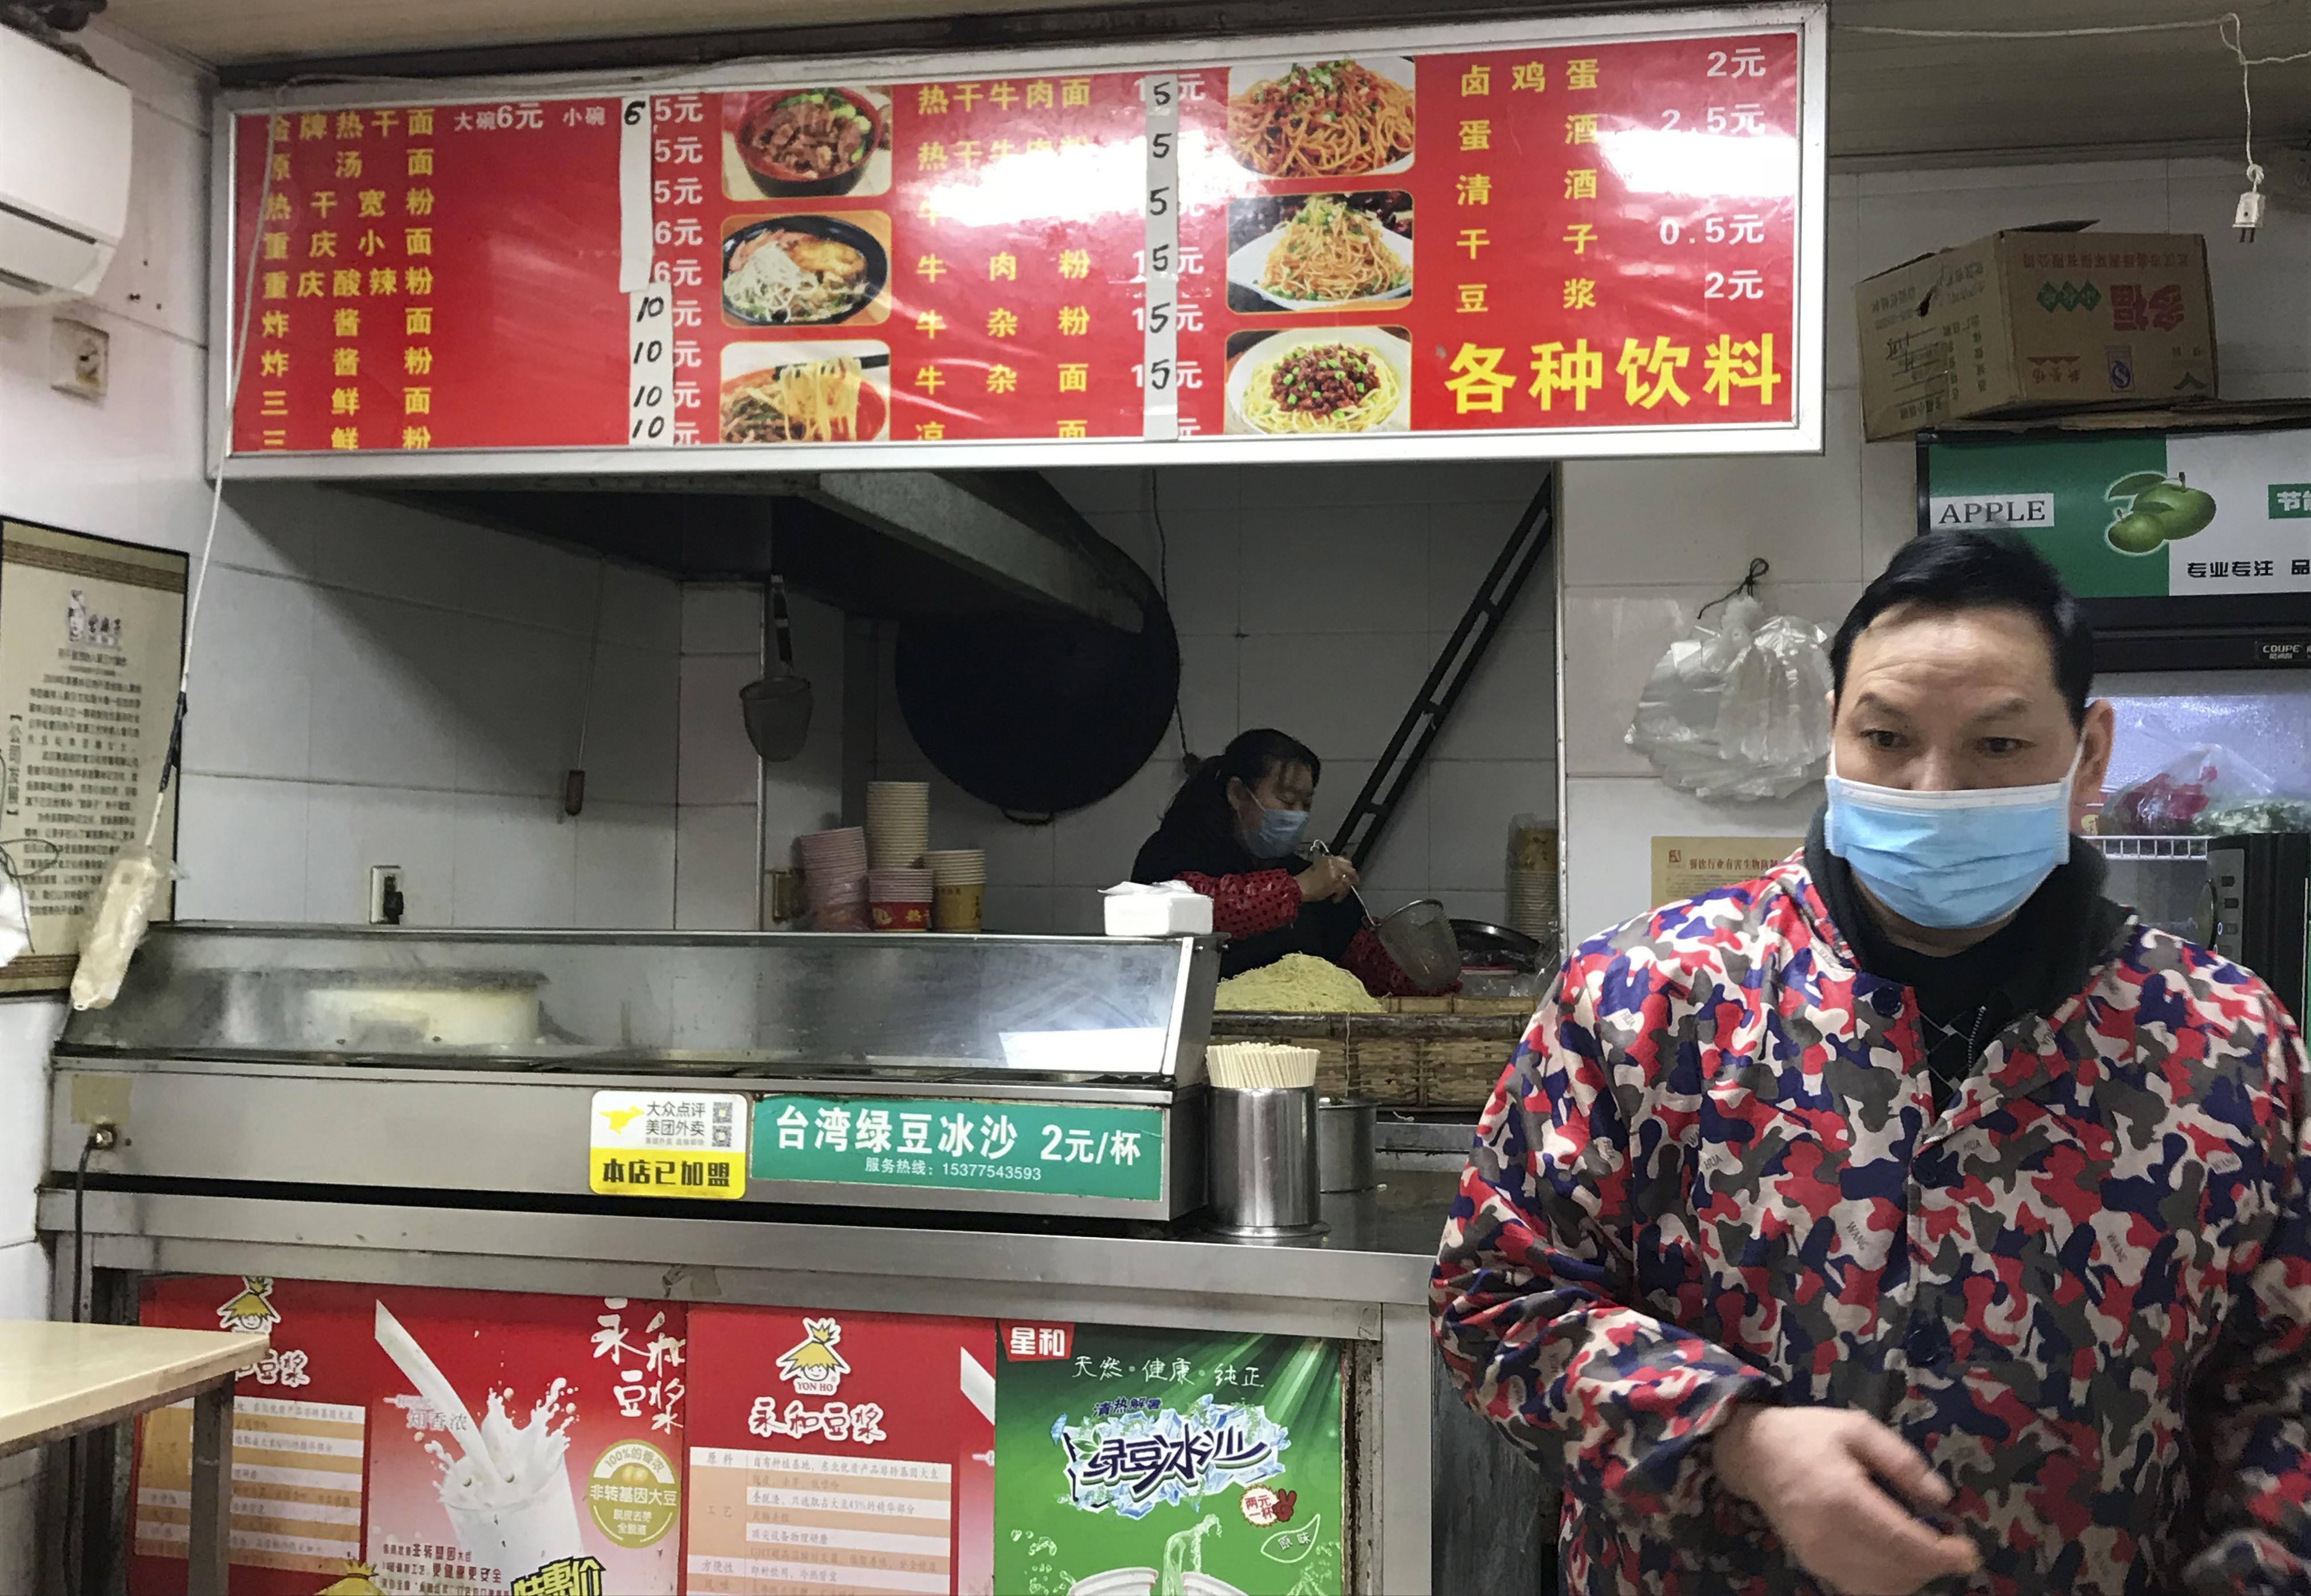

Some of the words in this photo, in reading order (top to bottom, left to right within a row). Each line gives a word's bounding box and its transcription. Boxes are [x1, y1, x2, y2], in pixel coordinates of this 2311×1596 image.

[1460, 58, 1599, 97] 卤鸡蛋
[1707, 47, 1766, 79] 2元
[918, 78, 1091, 115] 热干牛肉面
[1459, 113, 1599, 151] 蛋酒
[655, 136, 703, 164] 5元
[264, 187, 434, 221] 热干宽粉
[654, 177, 703, 205] 5元
[1456, 168, 1598, 206] 清酒
[264, 228, 433, 259] 重庆小面
[655, 218, 703, 247] 6元
[1456, 223, 1598, 259] 干子
[1659, 214, 1765, 245] 0.5元
[263, 266, 433, 299] 重庆酸辣粉
[655, 259, 702, 287] 6元
[916, 249, 1091, 283] 牛肉粉
[1456, 278, 1597, 313] 豆浆
[1705, 269, 1764, 300] 2元
[262, 307, 433, 338] 炸酱面
[915, 305, 1090, 339] 牛杂粉
[261, 346, 433, 377] 炸酱粉
[1444, 333, 1781, 414] 各种饮料
[915, 363, 1088, 394] 牛杂面
[261, 387, 432, 416] 三鲜面
[1938, 500, 2046, 524] APPLE
[2187, 560, 2274, 578] 专业专注
[647, 1101, 706, 1117] 大众点评
[645, 1119, 705, 1136] 美团外卖
[776, 1105, 1019, 1160] 台湾绿豆冰沙
[1040, 1124, 1142, 1166] 2元/杯
[603, 1158, 730, 1187] 本店已加盟
[1010, 1326, 1066, 1357] 星和
[613, 1370, 686, 1434] 豆浆
[797, 1381, 817, 1391] YON
[820, 1382, 833, 1392] HO
[750, 1398, 886, 1443] 永和豆浆
[1092, 1396, 1162, 1416] 清热解暑
[1063, 1424, 1269, 1501] 绿豆冰沙
[590, 1484, 677, 1506] 非转基因大豆
[1245, 1496, 1272, 1509] 两元
[1276, 1532, 1312, 1551] 原味
